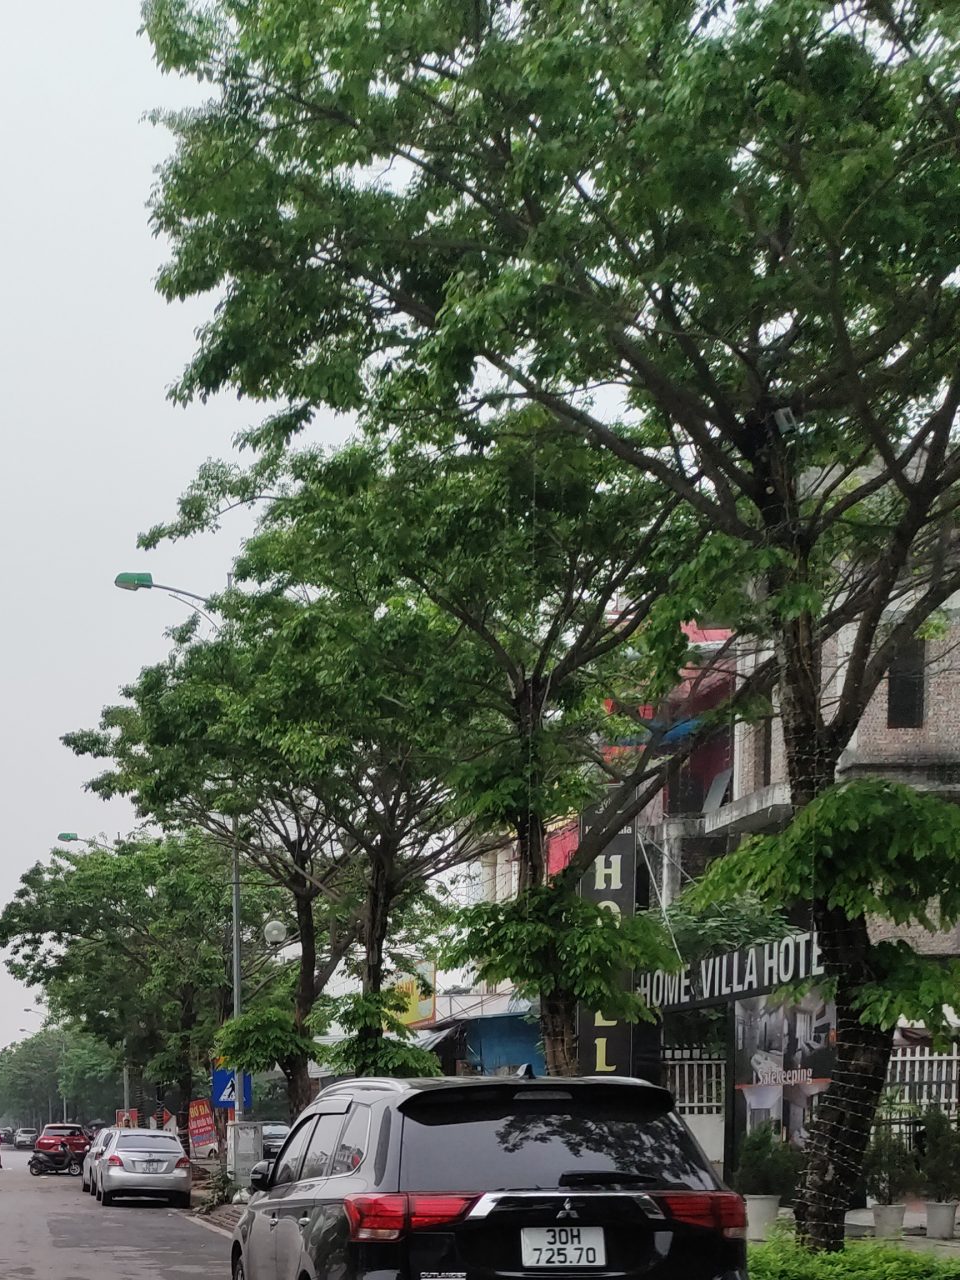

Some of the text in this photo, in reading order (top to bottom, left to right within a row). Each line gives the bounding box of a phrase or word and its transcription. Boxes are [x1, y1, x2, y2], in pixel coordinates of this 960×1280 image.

[640, 932, 825, 1009] HOME VILLA HOTE
[757, 1064, 813, 1086] Safekeeping
[546, 1229, 581, 1245] 30H
[532, 1247, 596, 1264] 725.70
